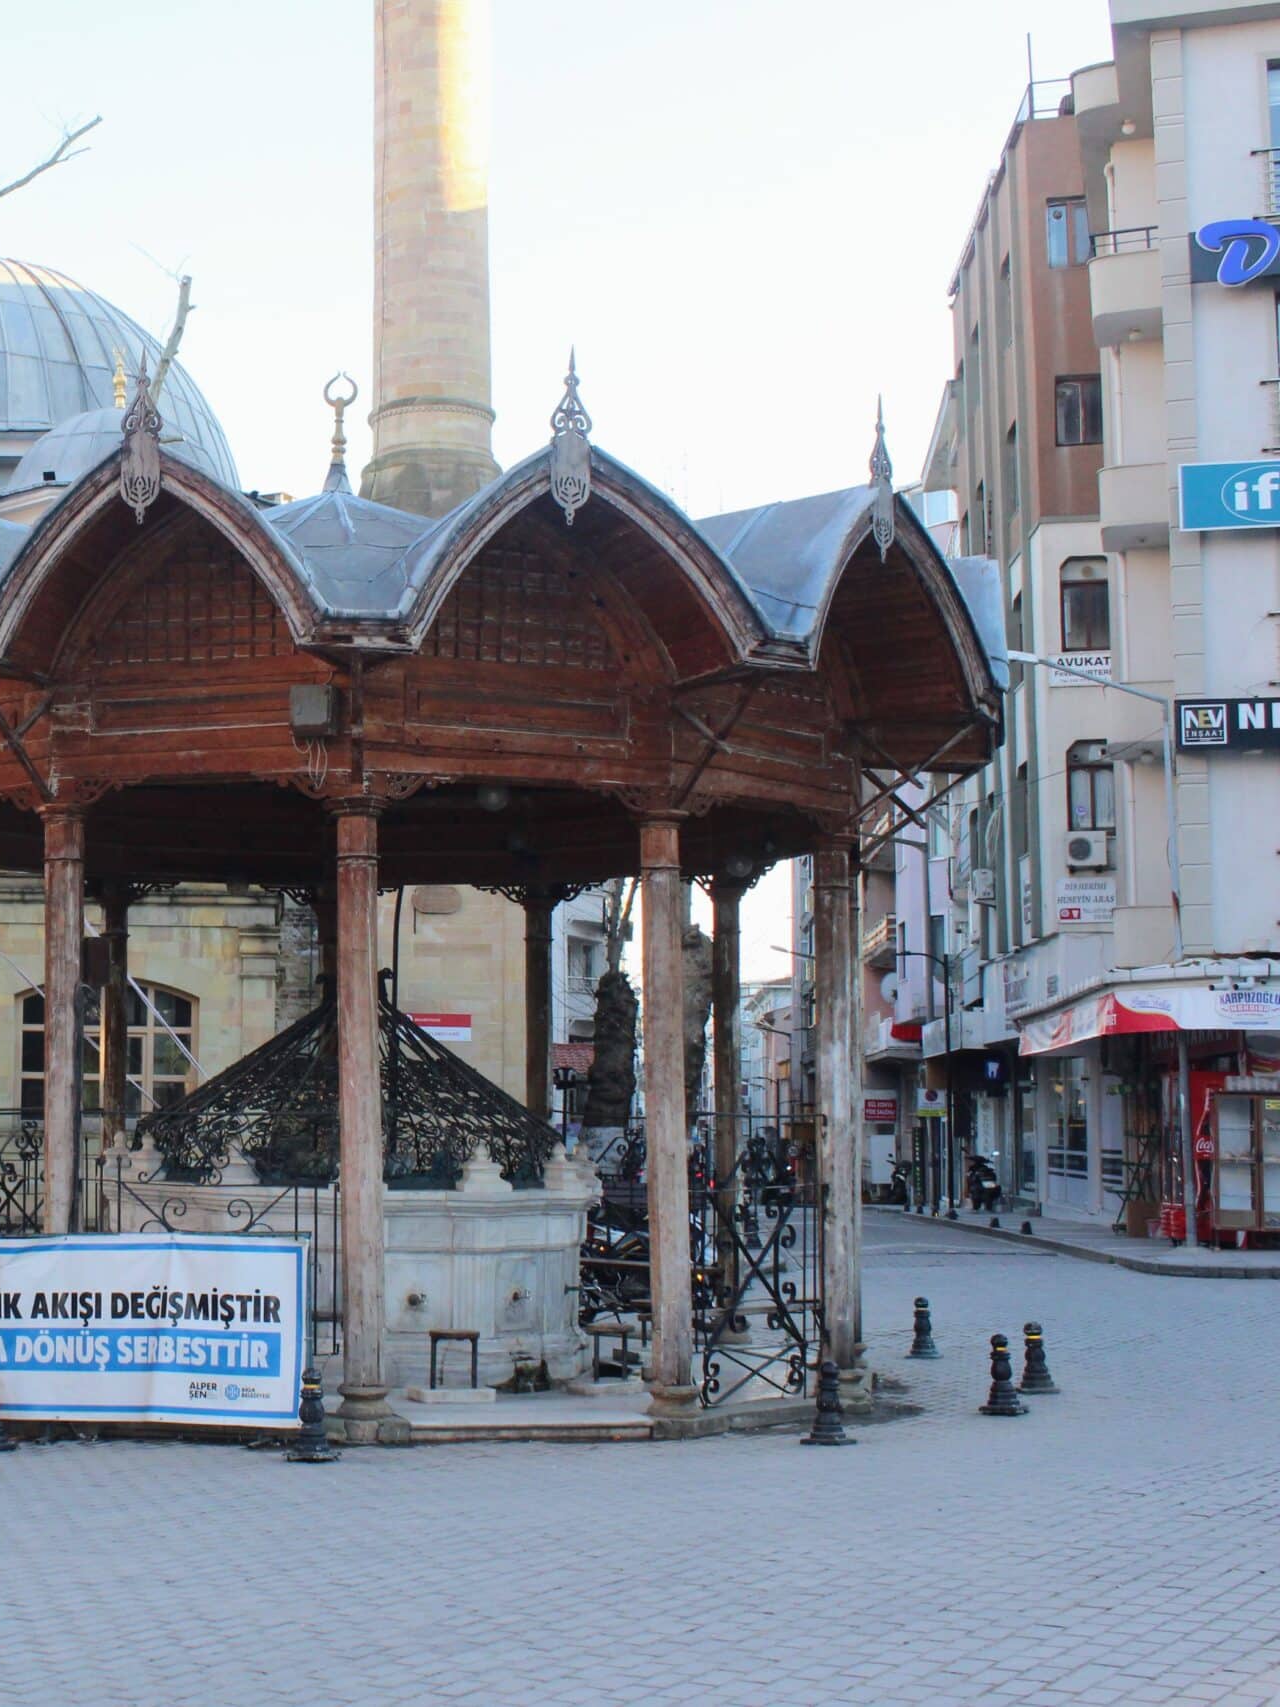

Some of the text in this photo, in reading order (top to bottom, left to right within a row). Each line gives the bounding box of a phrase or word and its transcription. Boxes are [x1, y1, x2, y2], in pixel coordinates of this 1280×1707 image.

[1056, 656, 1112, 667] AVUKAT
[1185, 709, 1223, 728] NEV
[31, 1291, 102, 1327] AKIŞI
[111, 1285, 281, 1330] DEĞİŞMİŞTİR
[14, 1329, 111, 1372] DÖNÜŞ
[117, 1333, 269, 1369] SERBESTTİR
[189, 1381, 217, 1391] ALPER
